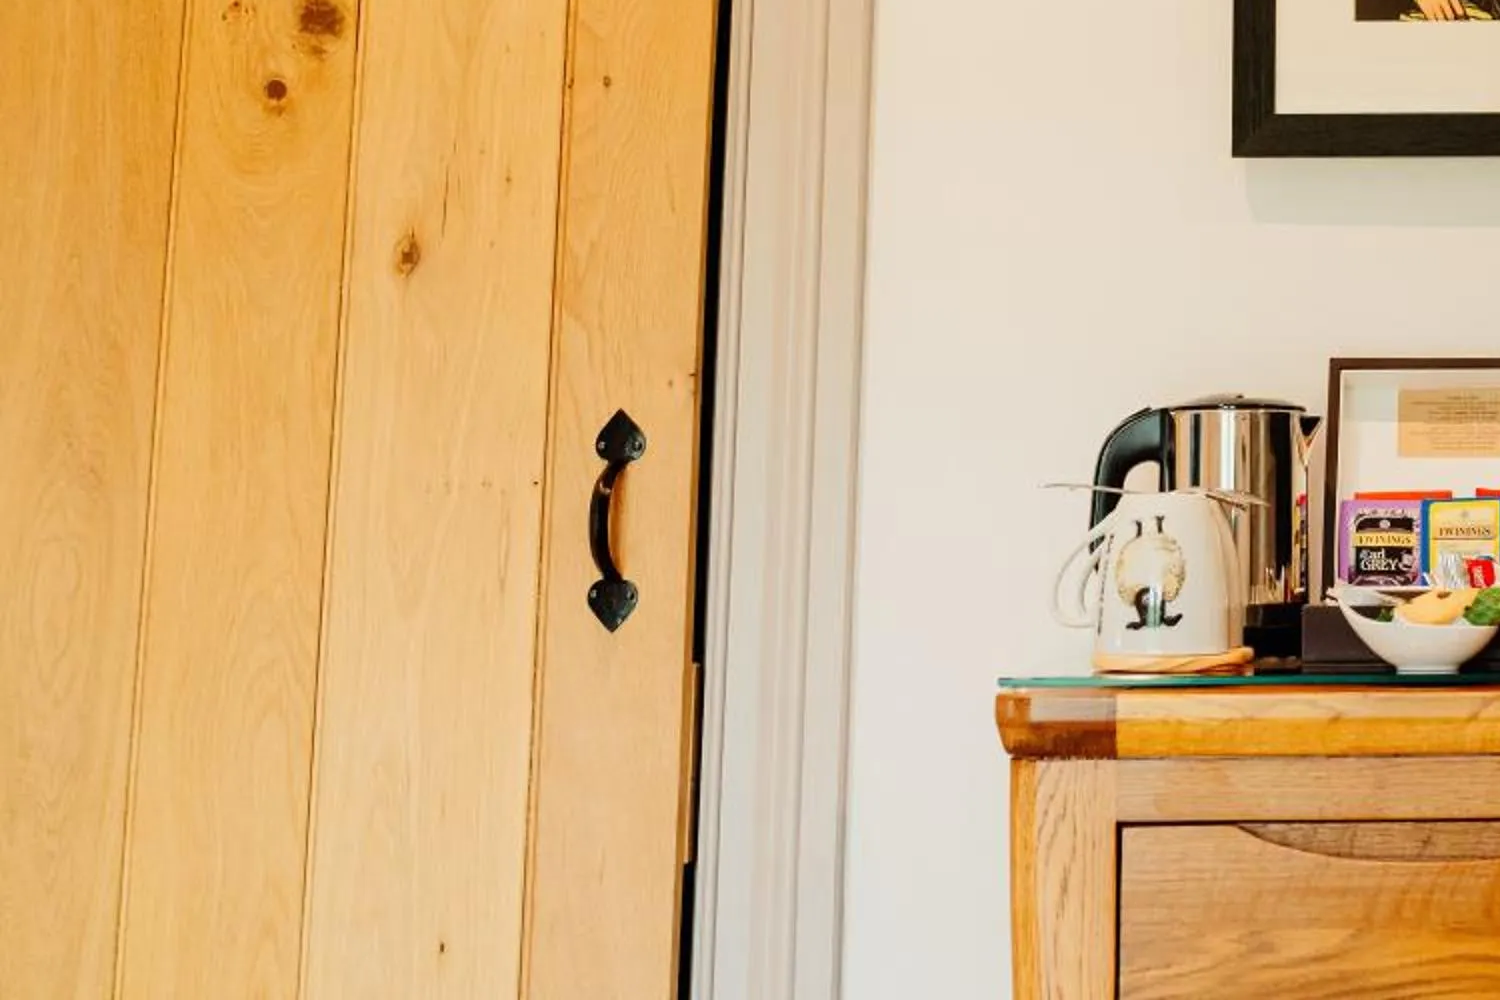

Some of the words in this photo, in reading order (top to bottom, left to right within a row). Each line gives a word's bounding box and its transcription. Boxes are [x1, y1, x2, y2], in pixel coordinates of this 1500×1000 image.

[1438, 526, 1491, 537] TWININGS
[1359, 534, 1412, 545] TWININGS
[1361, 560, 1398, 571] GREY
